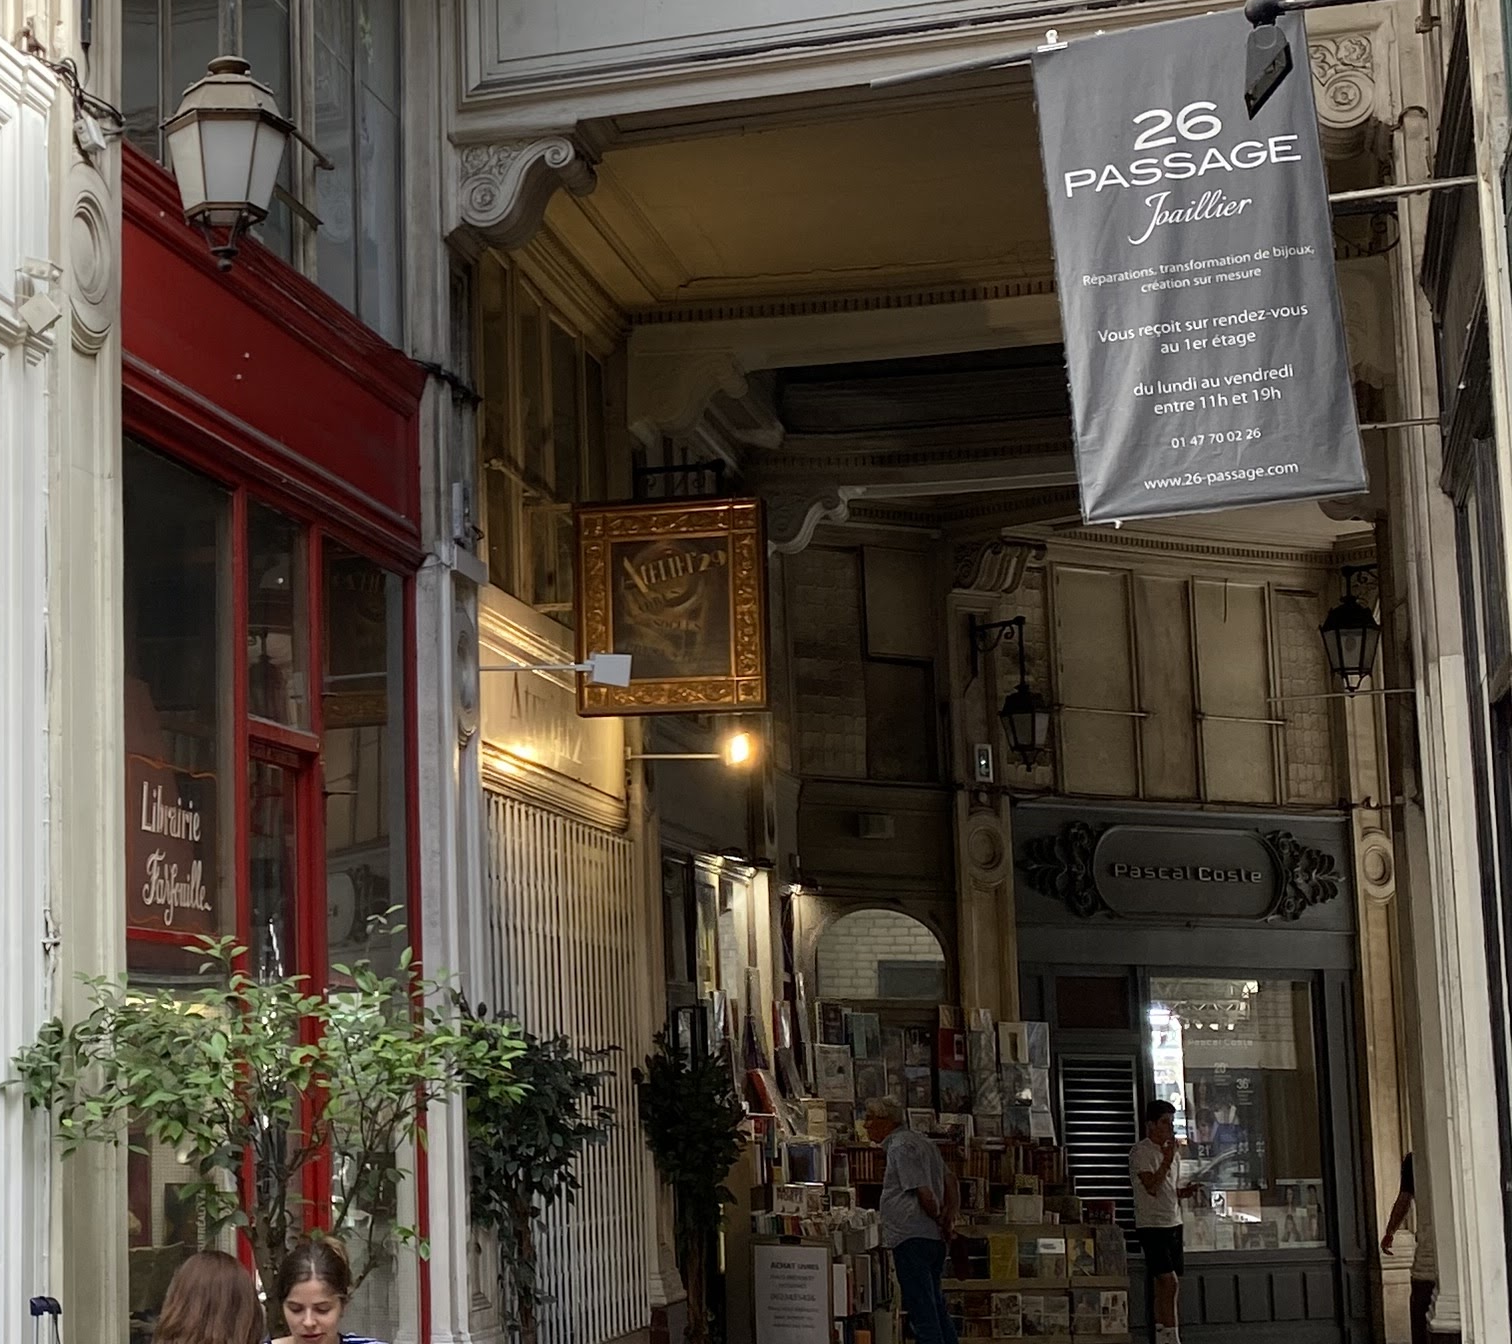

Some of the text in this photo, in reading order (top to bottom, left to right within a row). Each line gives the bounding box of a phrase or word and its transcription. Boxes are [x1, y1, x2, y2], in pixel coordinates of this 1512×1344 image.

[1133, 101, 1223, 150] 26
[1065, 134, 1302, 197] PASSAGE
[1128, 189, 1252, 244] Joaillier
[1160, 252, 1251, 275] transformation
[1254, 249, 1270, 260] de
[1273, 244, 1315, 260] bijoux,
[1141, 268, 1262, 293] création sur mesure
[1098, 304, 1308, 343] Vous reçoit sur rendez-vous
[1161, 331, 1257, 354] au 1er étage
[1133, 364, 1294, 397] du lundi au vendredi
[1154, 386, 1282, 415] entre 11h et 19h
[1171, 428, 1262, 448] 01 47 70 02 26
[1144, 462, 1299, 490] www.26-passage.com
[141, 781, 201, 842] Librairie
[1114, 863, 1263, 883] Pascal Coste
